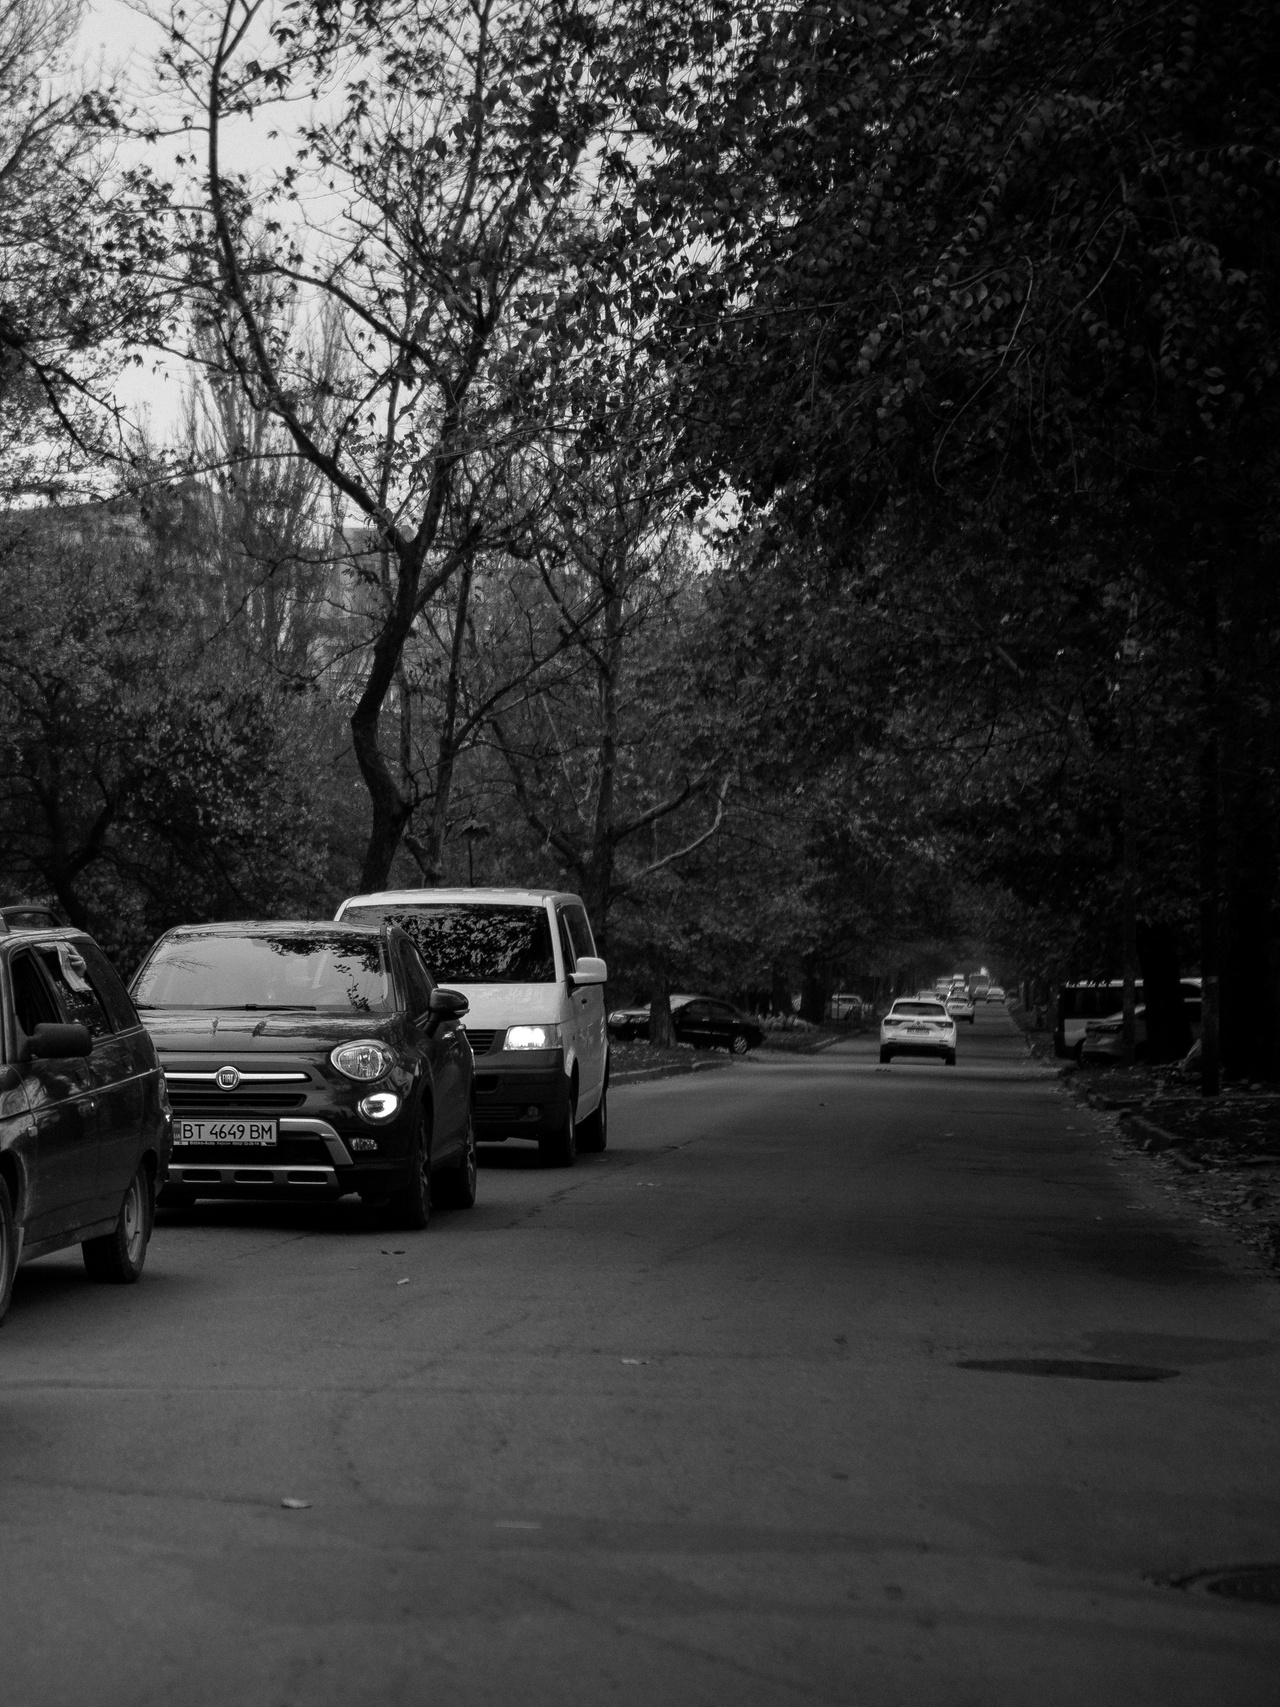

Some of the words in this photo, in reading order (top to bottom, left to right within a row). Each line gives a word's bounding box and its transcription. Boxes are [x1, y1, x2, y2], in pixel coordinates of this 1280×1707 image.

[183, 1123, 205, 1139] BT
[209, 1124, 245, 1140] 4649
[250, 1124, 272, 1140] BM
